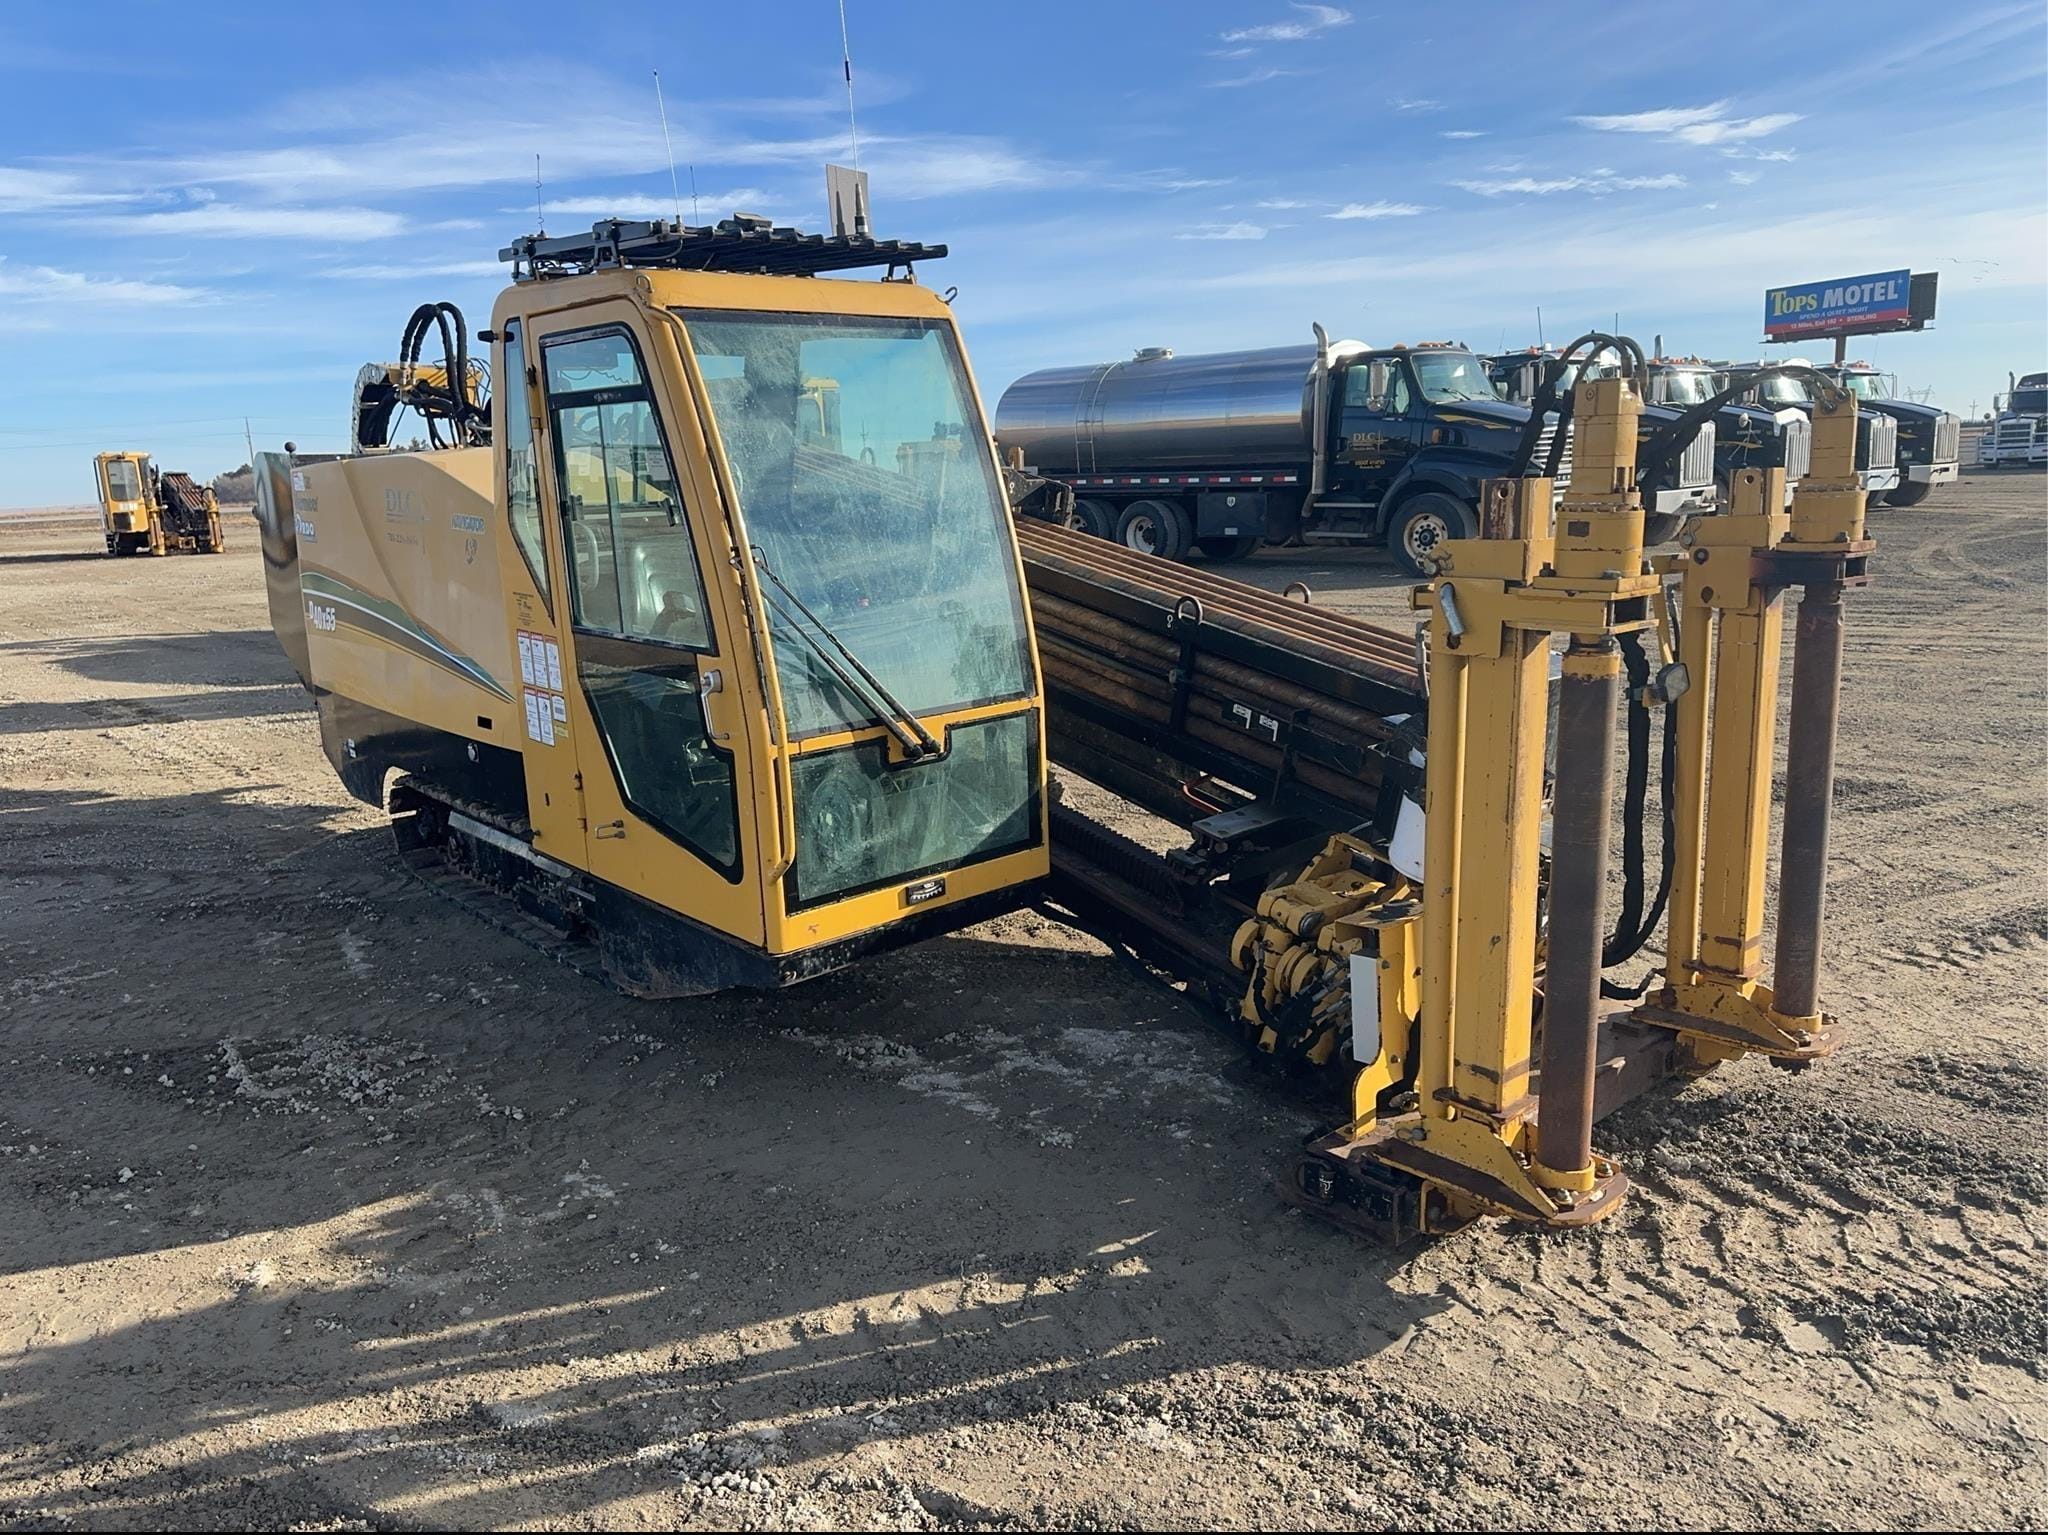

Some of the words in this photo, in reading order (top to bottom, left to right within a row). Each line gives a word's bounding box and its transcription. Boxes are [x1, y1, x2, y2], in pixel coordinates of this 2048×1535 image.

[1771, 290, 1817, 316] Tops
[1822, 279, 1898, 309] MOTEL
[1799, 312, 1819, 320] SPEND
[1827, 309, 1846, 317] QUIET
[1847, 306, 1869, 314] NIGHT
[1846, 313, 1877, 322] STERLING
[1353, 432, 1376, 441] DLC
